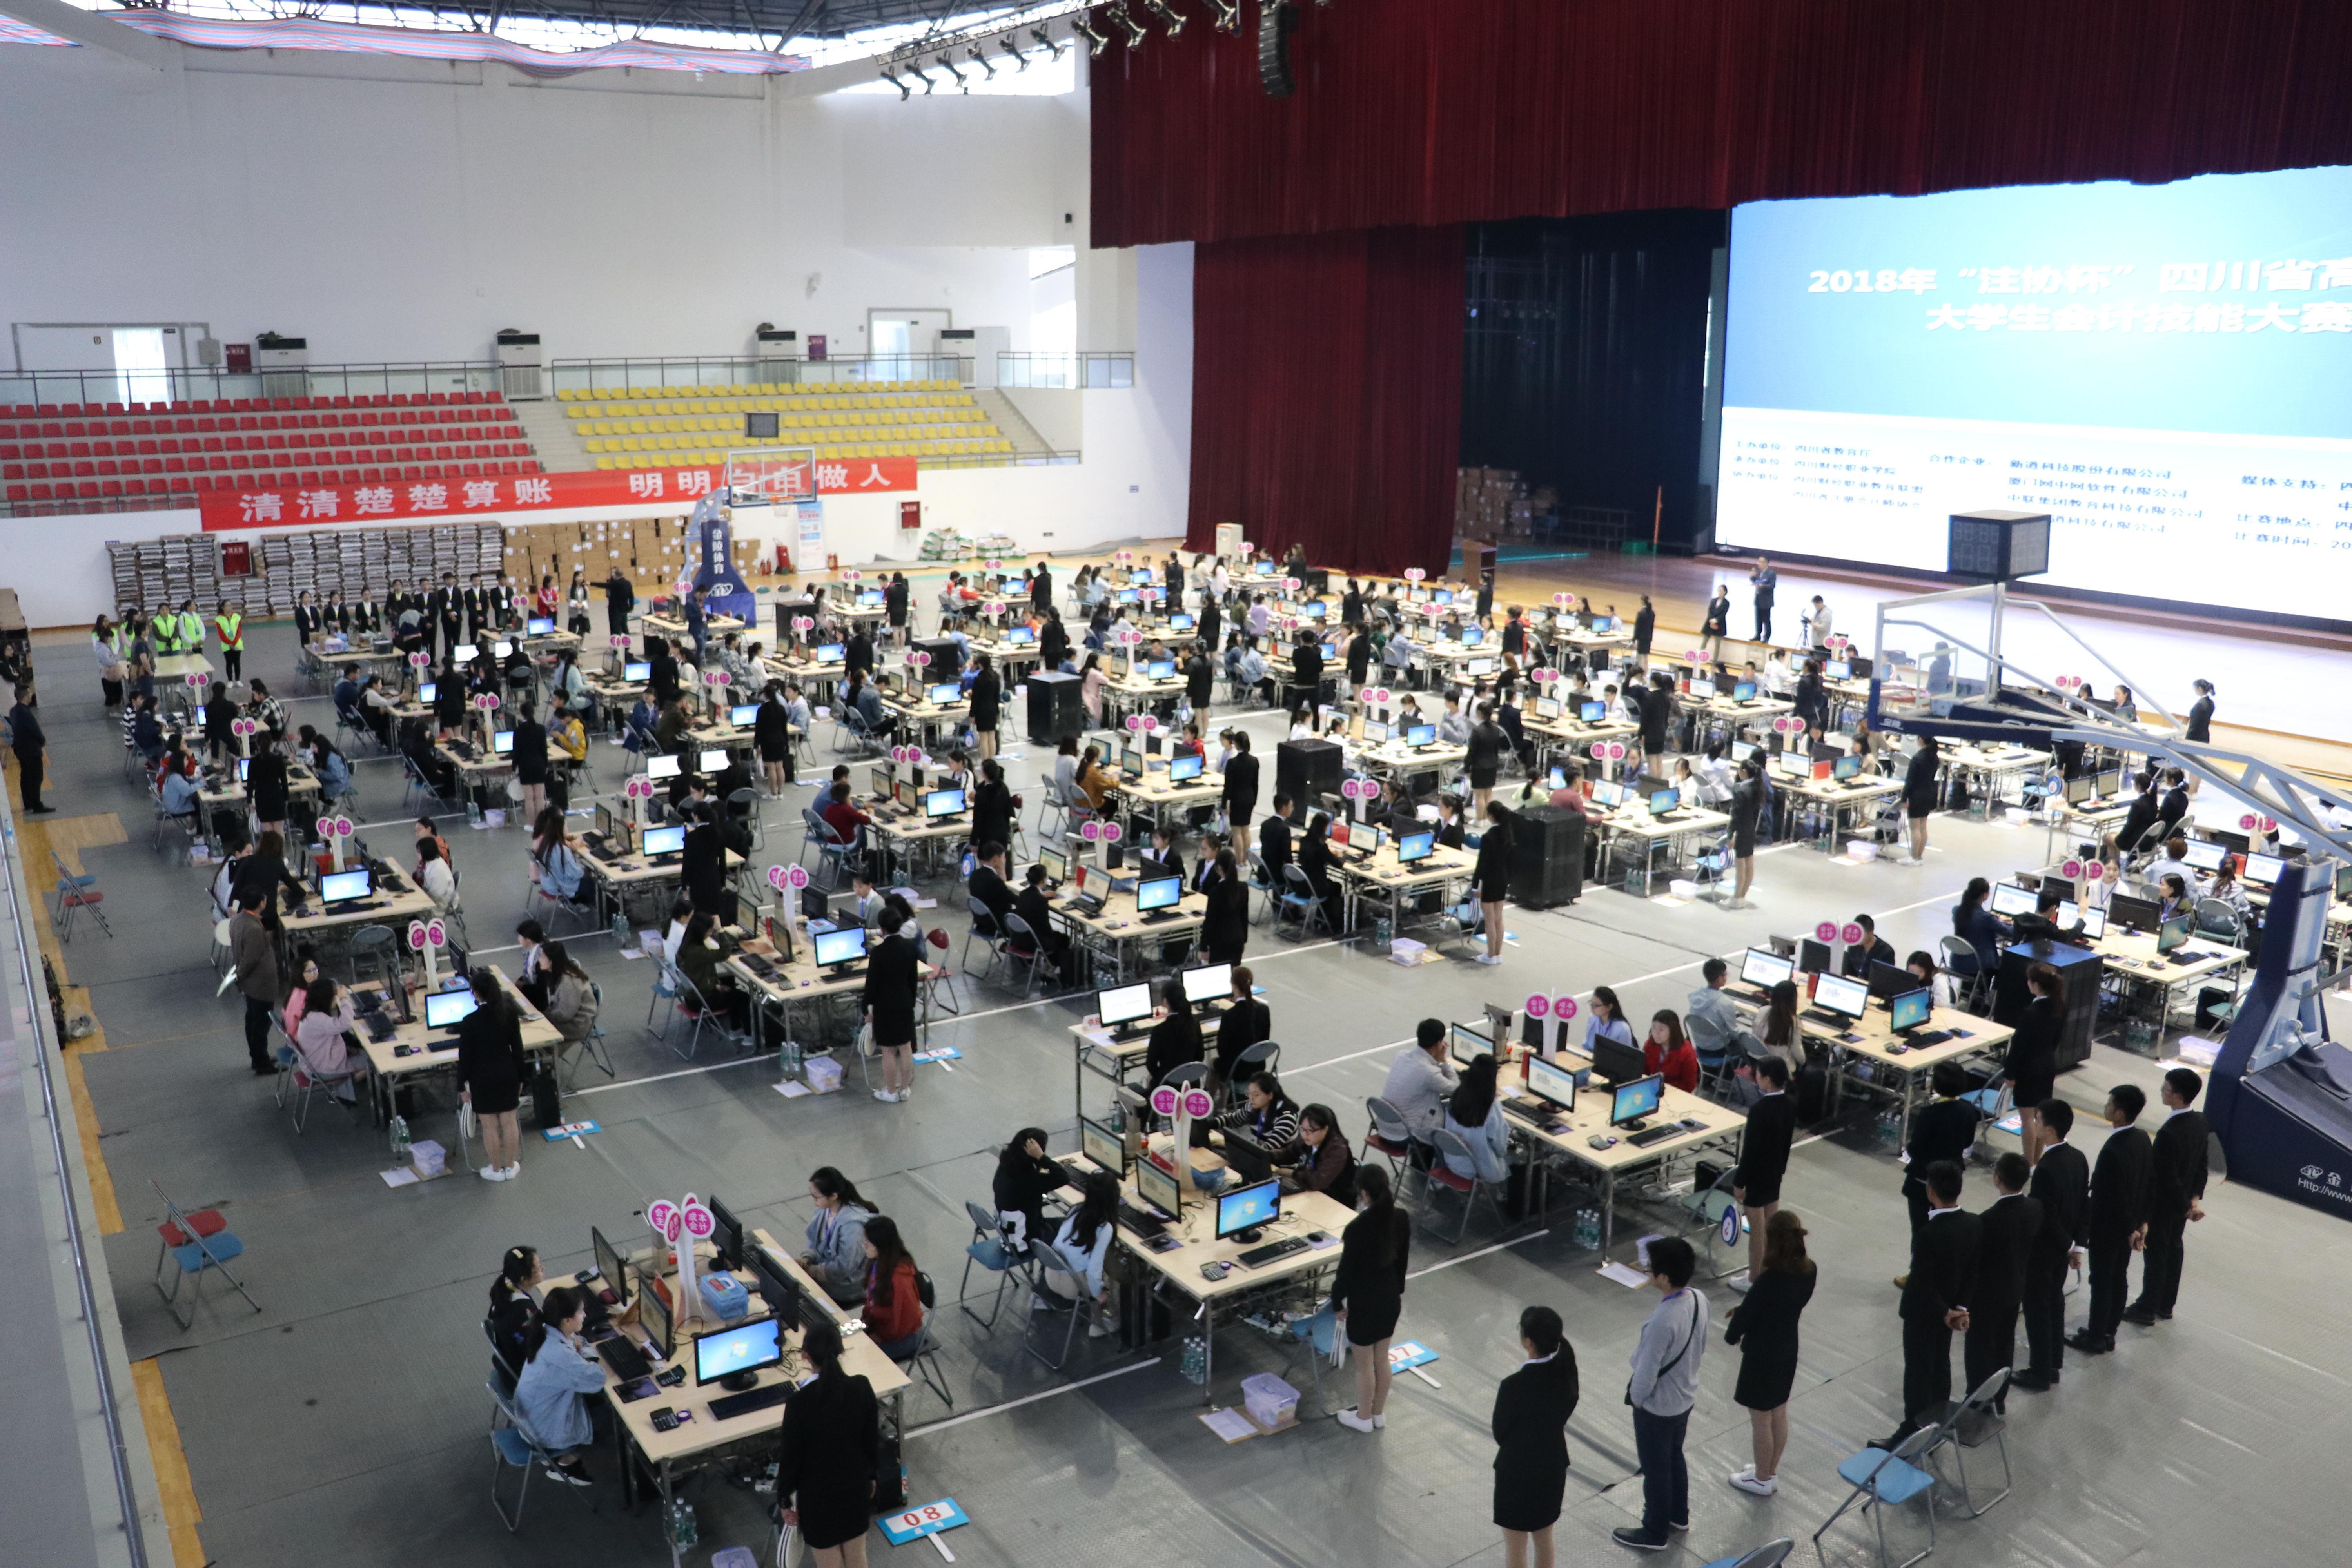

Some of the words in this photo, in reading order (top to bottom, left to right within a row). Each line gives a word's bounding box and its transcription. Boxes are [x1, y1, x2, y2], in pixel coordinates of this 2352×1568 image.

[1808, 267, 1937, 295] 2018年
[2010, 459, 2171, 479] 新道科技股份有限公司
[240, 478, 552, 522] 清清楚楚算账
[904, 1506, 941, 1526] 08
